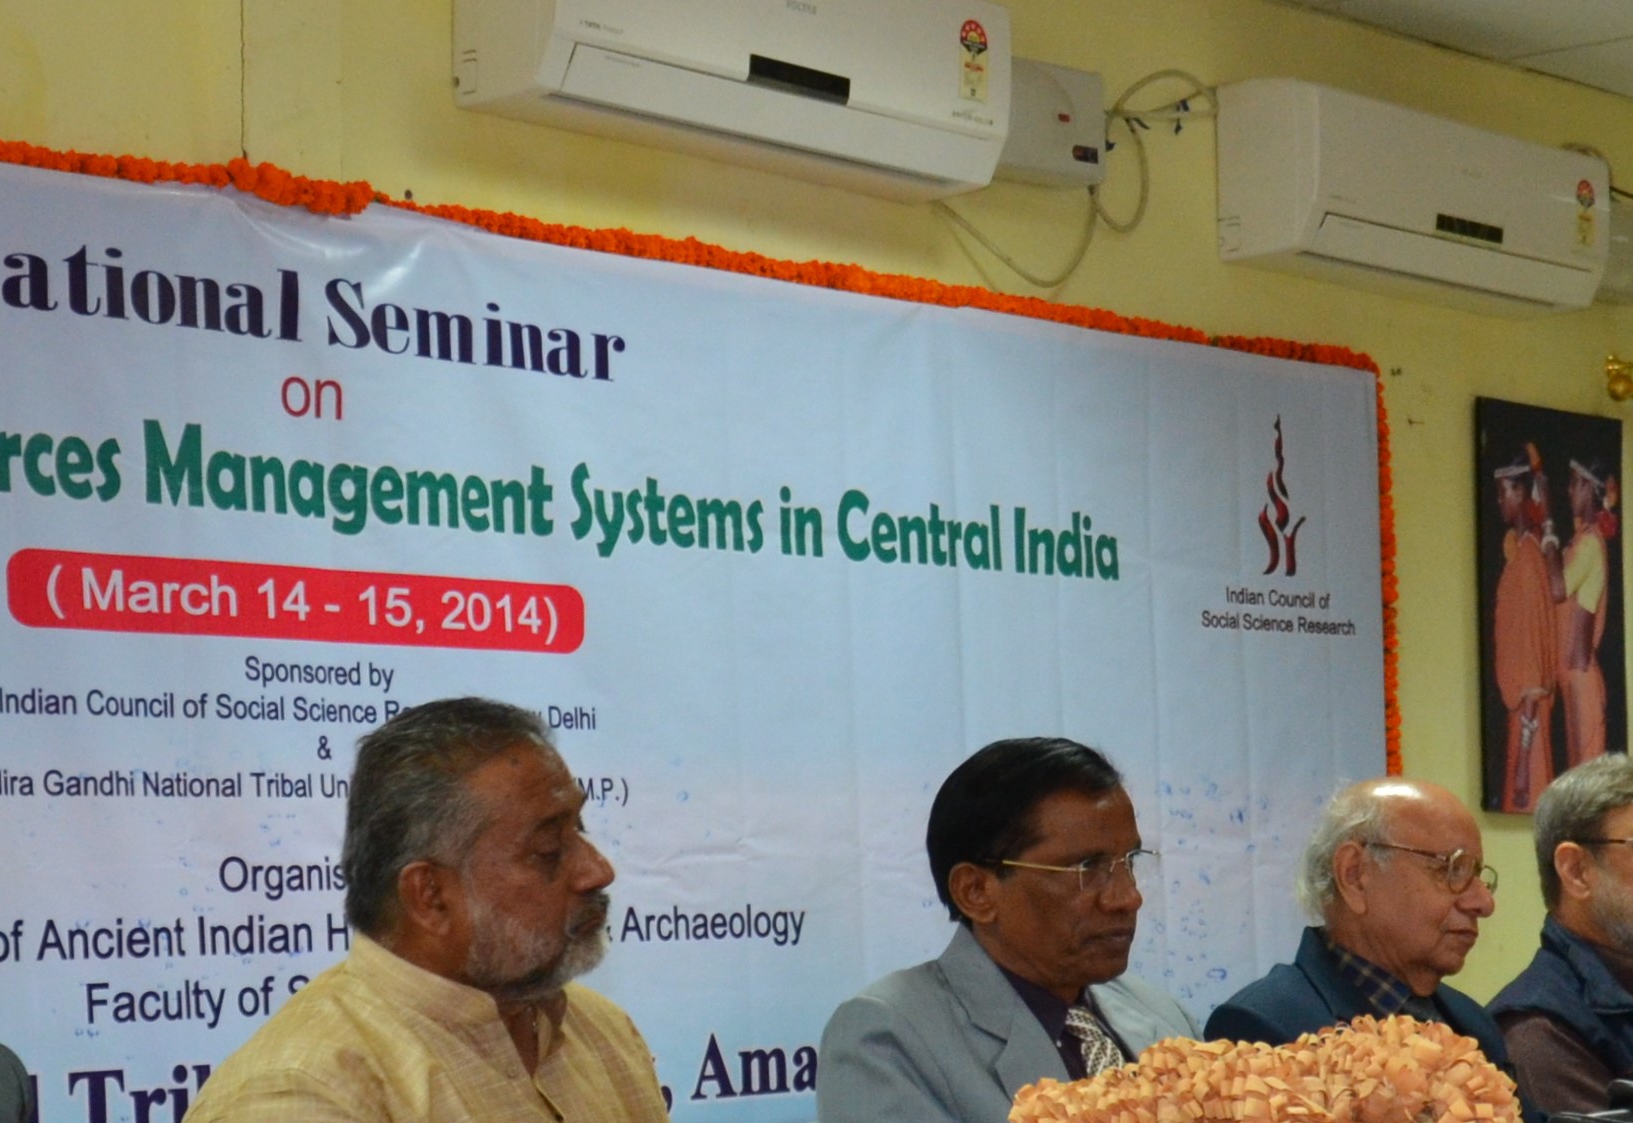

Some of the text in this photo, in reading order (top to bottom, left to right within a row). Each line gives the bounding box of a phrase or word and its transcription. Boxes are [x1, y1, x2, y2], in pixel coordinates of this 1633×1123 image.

[327, 277, 626, 383] Seminar
[280, 375, 344, 421] on
[143, 419, 555, 537] Management
[570, 461, 765, 559] Systems
[779, 485, 824, 559] in
[837, 488, 1003, 574] Central
[1014, 505, 1120, 582] India
[81, 566, 238, 619] March
[258, 577, 311, 622] 14
[359, 584, 426, 635] 15,
[441, 589, 560, 645] 2014)
[1225, 585, 1332, 611] Indian Council of
[1201, 610, 1357, 637] Social Science Research
[244, 655, 395, 691] Sponsored by
[85, 688, 176, 720] Council
[180, 691, 210, 720] of
[214, 693, 287, 723] Social
[292, 696, 378, 725] Science
[547, 705, 597, 731] Delhi
[317, 735, 333, 760] &
[42, 769, 136, 798] Gandhi
[141, 770, 243, 799] National
[248, 771, 313, 799] Tribal
[573, 777, 629, 808] M.P.)
[218, 855, 348, 902] Organis
[36, 917, 186, 963] Ancient
[197, 912, 315, 958] Indian
[620, 903, 806, 946] Archaeology
[85, 979, 226, 1029] Faculty
[237, 976, 277, 1018] of
